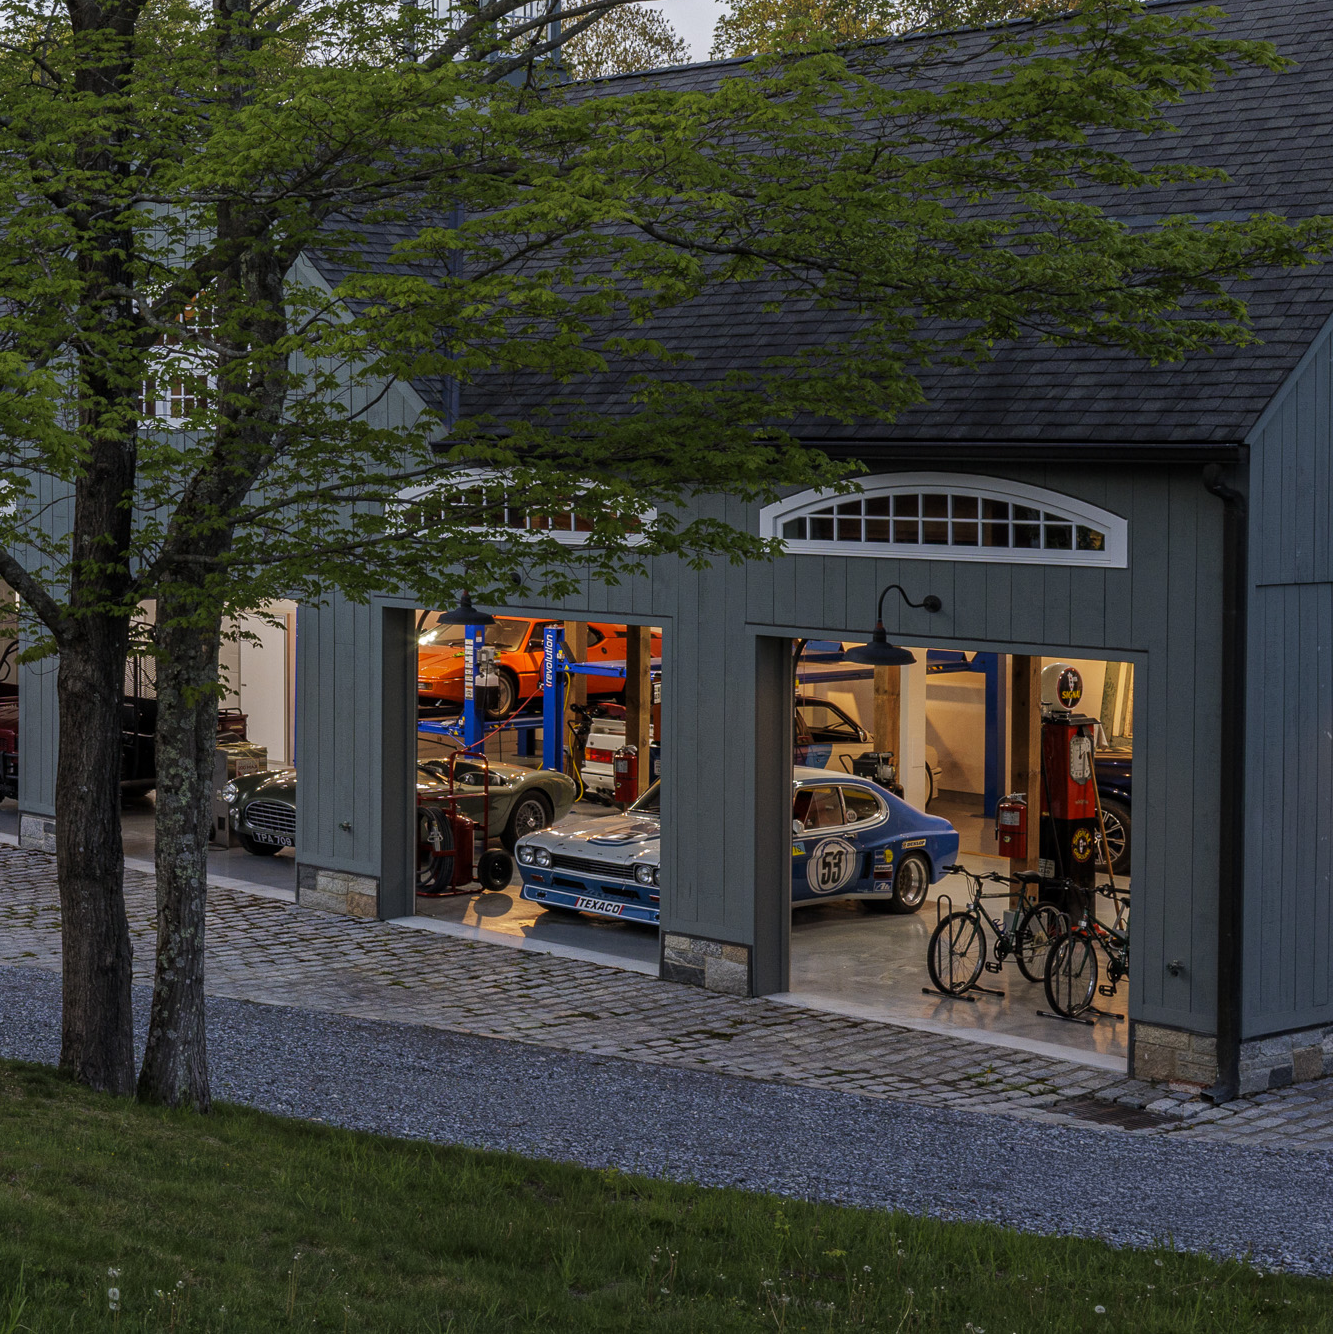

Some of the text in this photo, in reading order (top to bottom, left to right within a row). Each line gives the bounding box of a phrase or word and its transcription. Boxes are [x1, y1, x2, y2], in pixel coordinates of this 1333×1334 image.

[1061, 690, 1081, 699] SIGNAL
[256, 832, 292, 846] TPA 709
[906, 840, 926, 848] DUNLOP
[820, 850, 844, 886] 53
[579, 898, 621, 914] TEXACO
